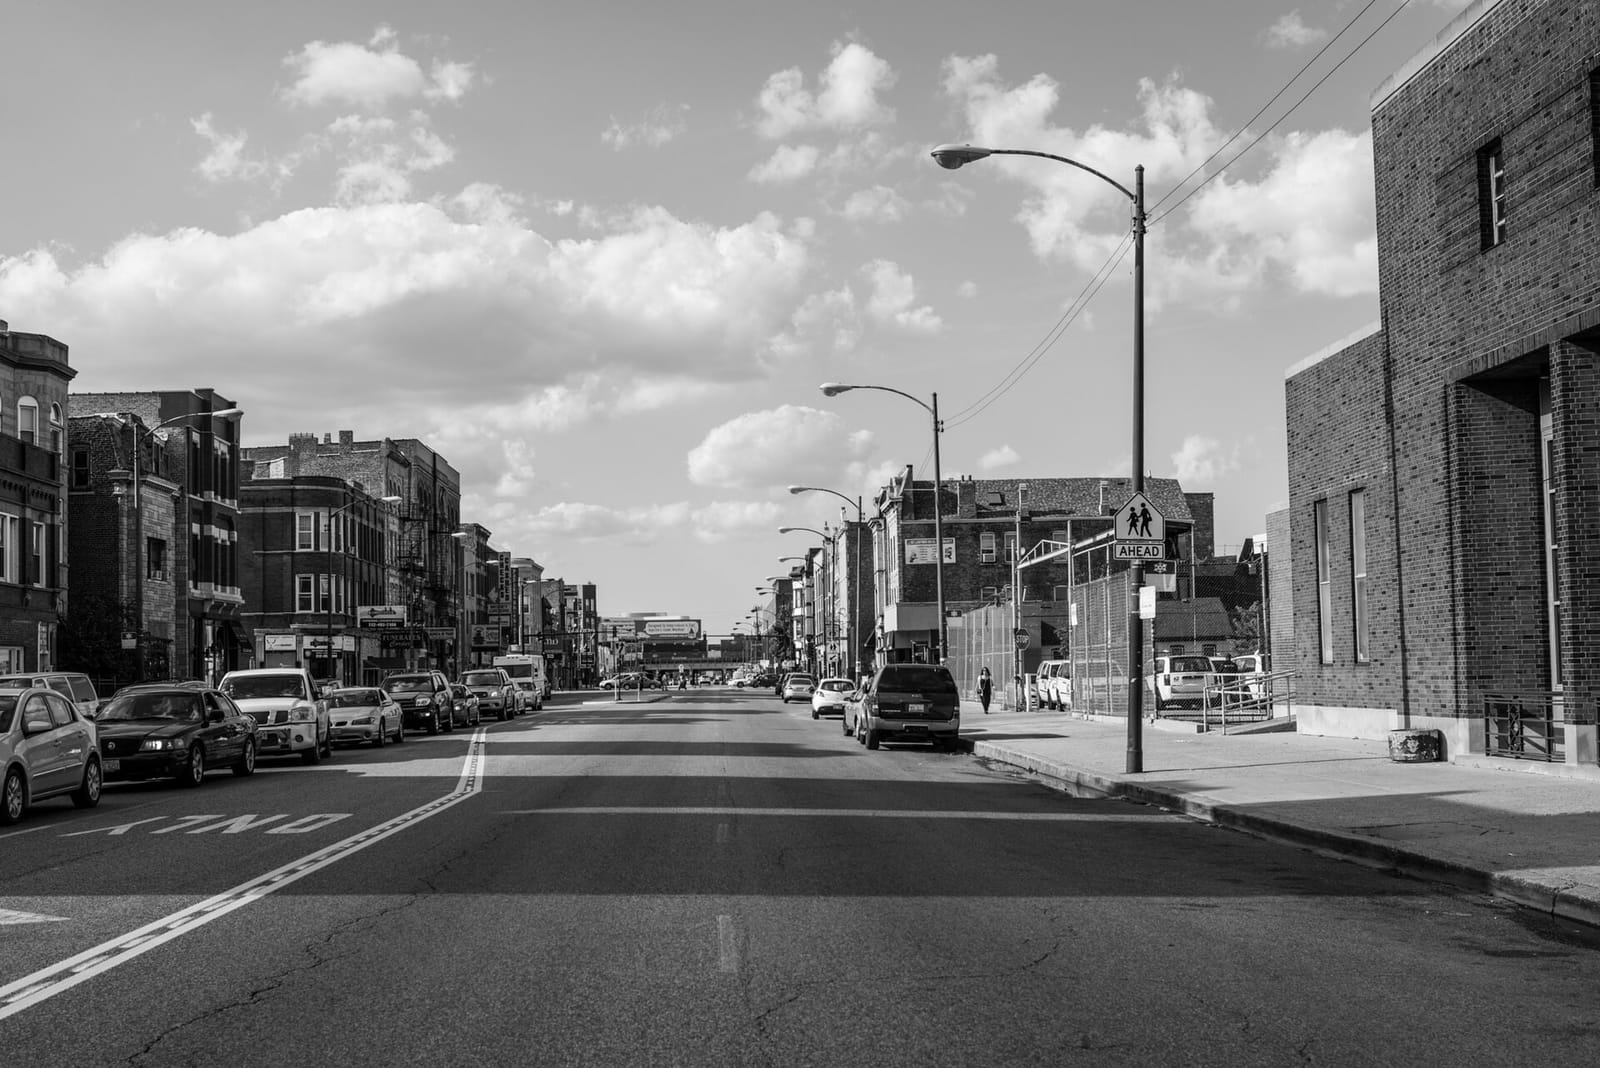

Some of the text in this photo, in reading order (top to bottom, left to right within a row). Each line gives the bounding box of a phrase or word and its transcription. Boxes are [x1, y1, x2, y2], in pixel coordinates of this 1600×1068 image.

[1119, 546, 1160, 557] AHEAD
[1015, 634, 1030, 644] STOP
[56, 813, 354, 837] ONLY
